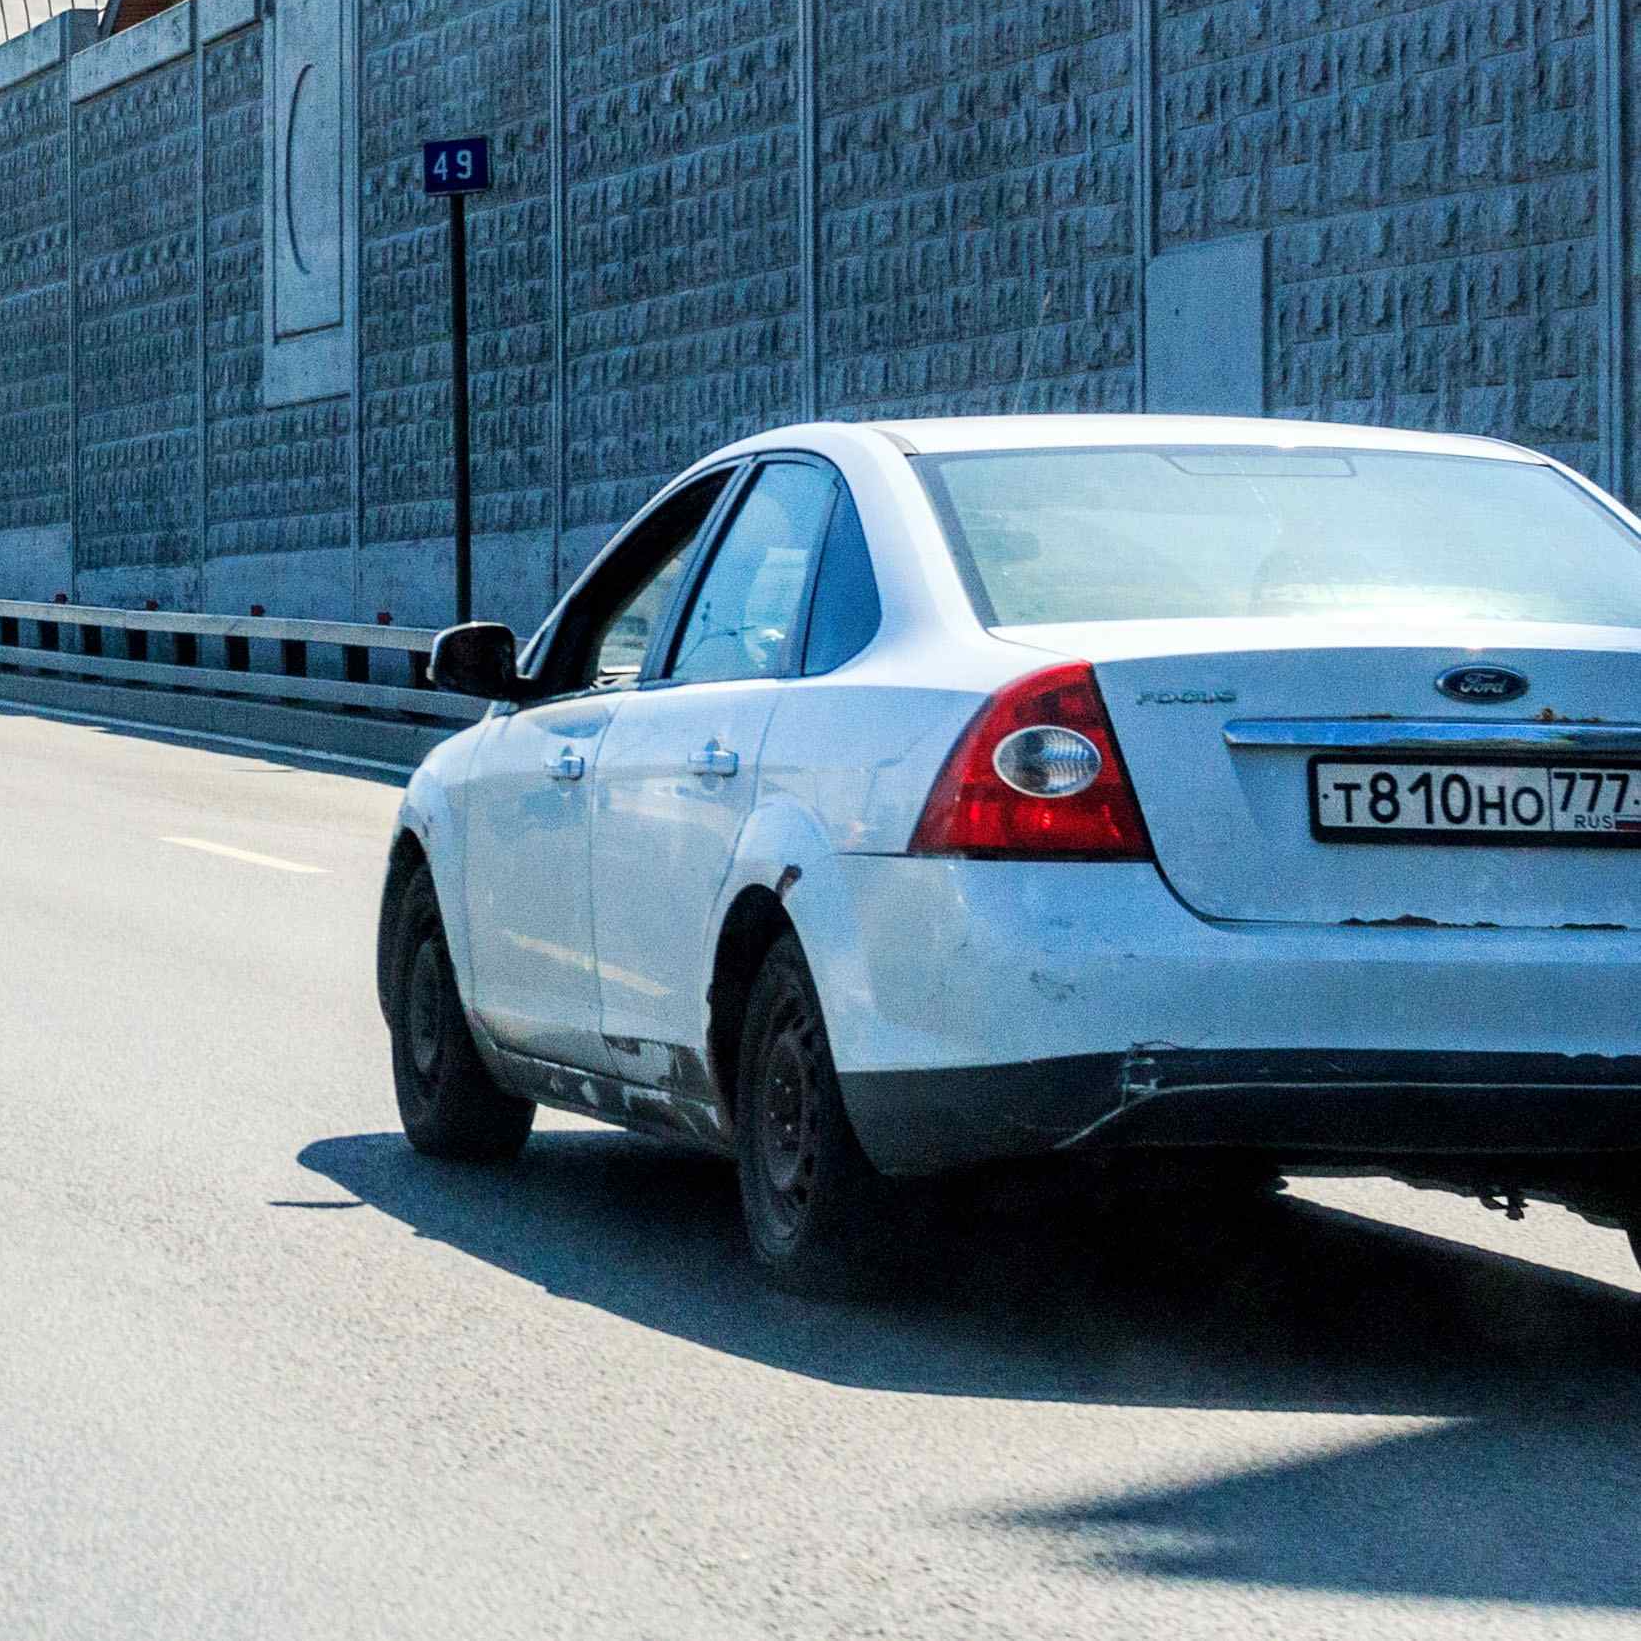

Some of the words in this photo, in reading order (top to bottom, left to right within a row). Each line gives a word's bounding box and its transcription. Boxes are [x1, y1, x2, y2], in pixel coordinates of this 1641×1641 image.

[432, 149, 473, 181] 49
[1459, 672, 1508, 695] Ford
[1332, 771, 1546, 827] Т810НО
[1553, 771, 1630, 813] 777
[1574, 814, 1614, 830] RUS
